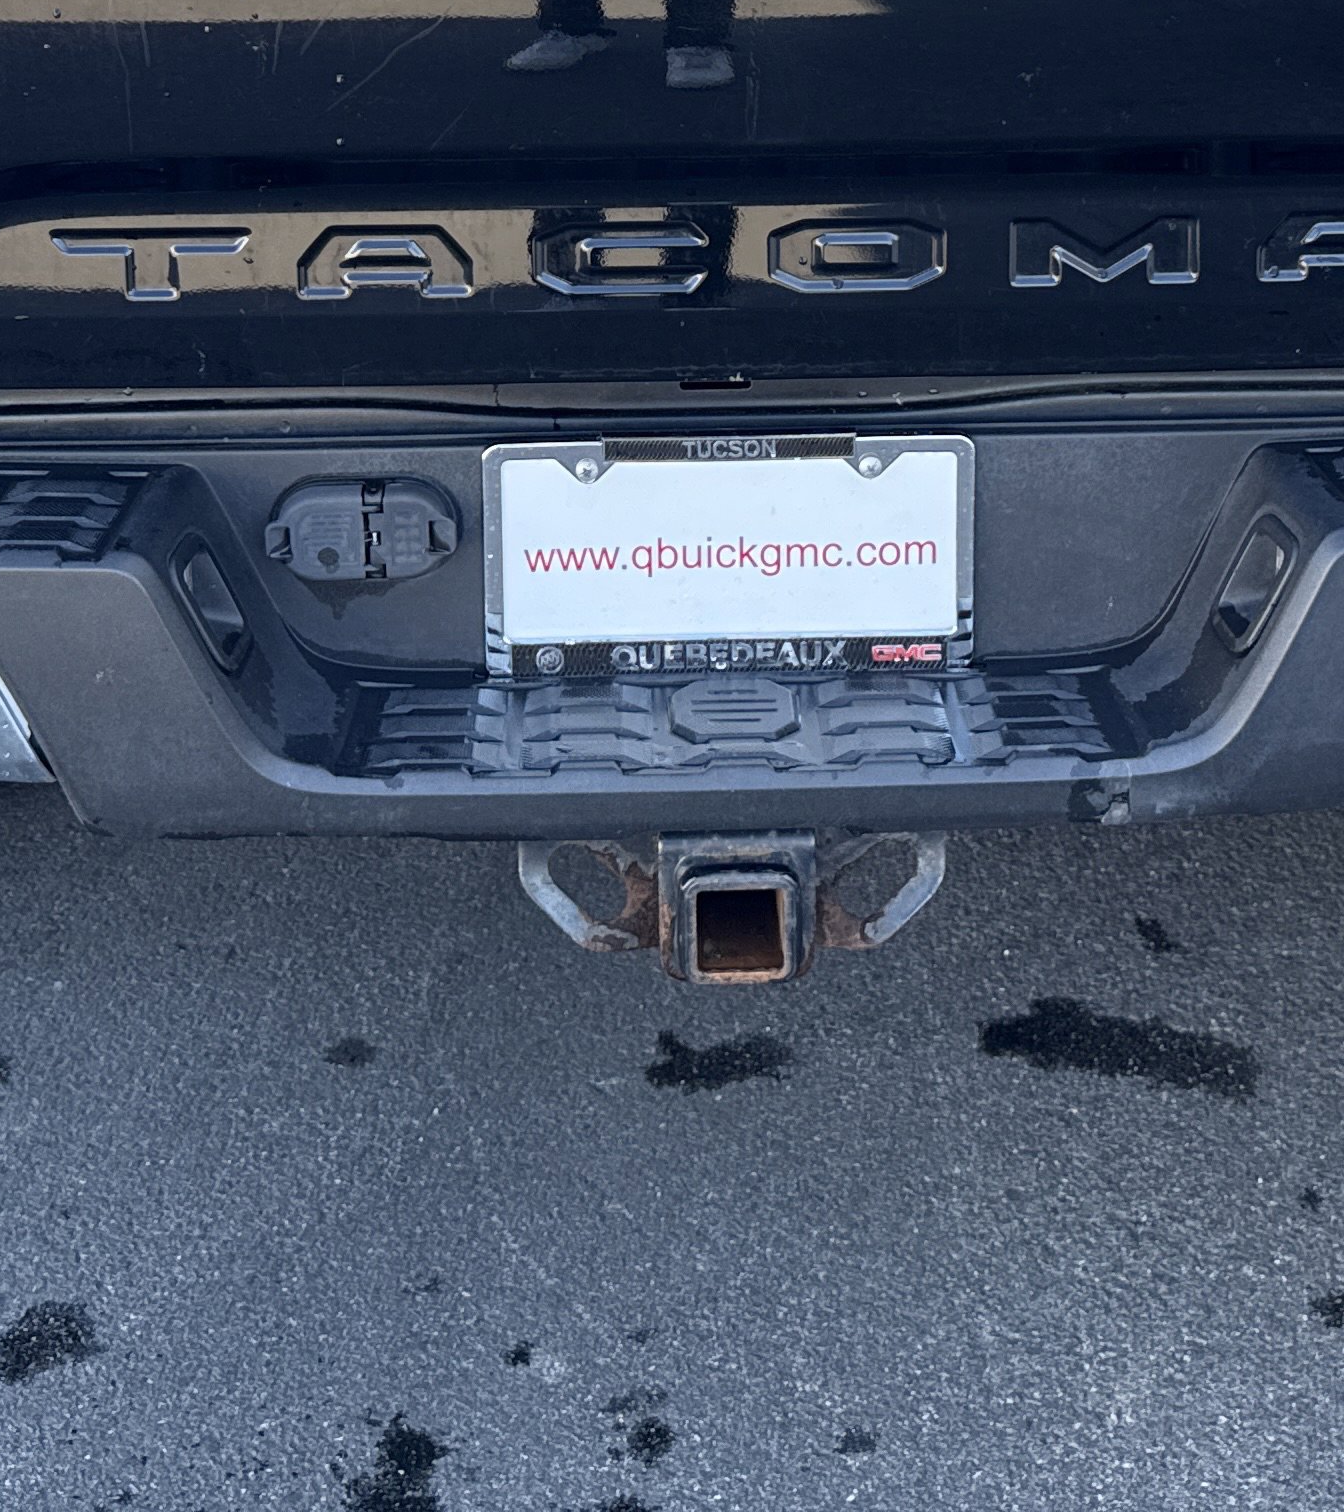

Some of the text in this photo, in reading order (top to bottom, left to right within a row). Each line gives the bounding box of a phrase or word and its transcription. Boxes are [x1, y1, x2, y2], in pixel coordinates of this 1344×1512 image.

[682, 439, 777, 458] TUCSON
[524, 536, 938, 576] www.qbuickgmc.com
[610, 640, 943, 671] QUEBEDEAUX GMC
